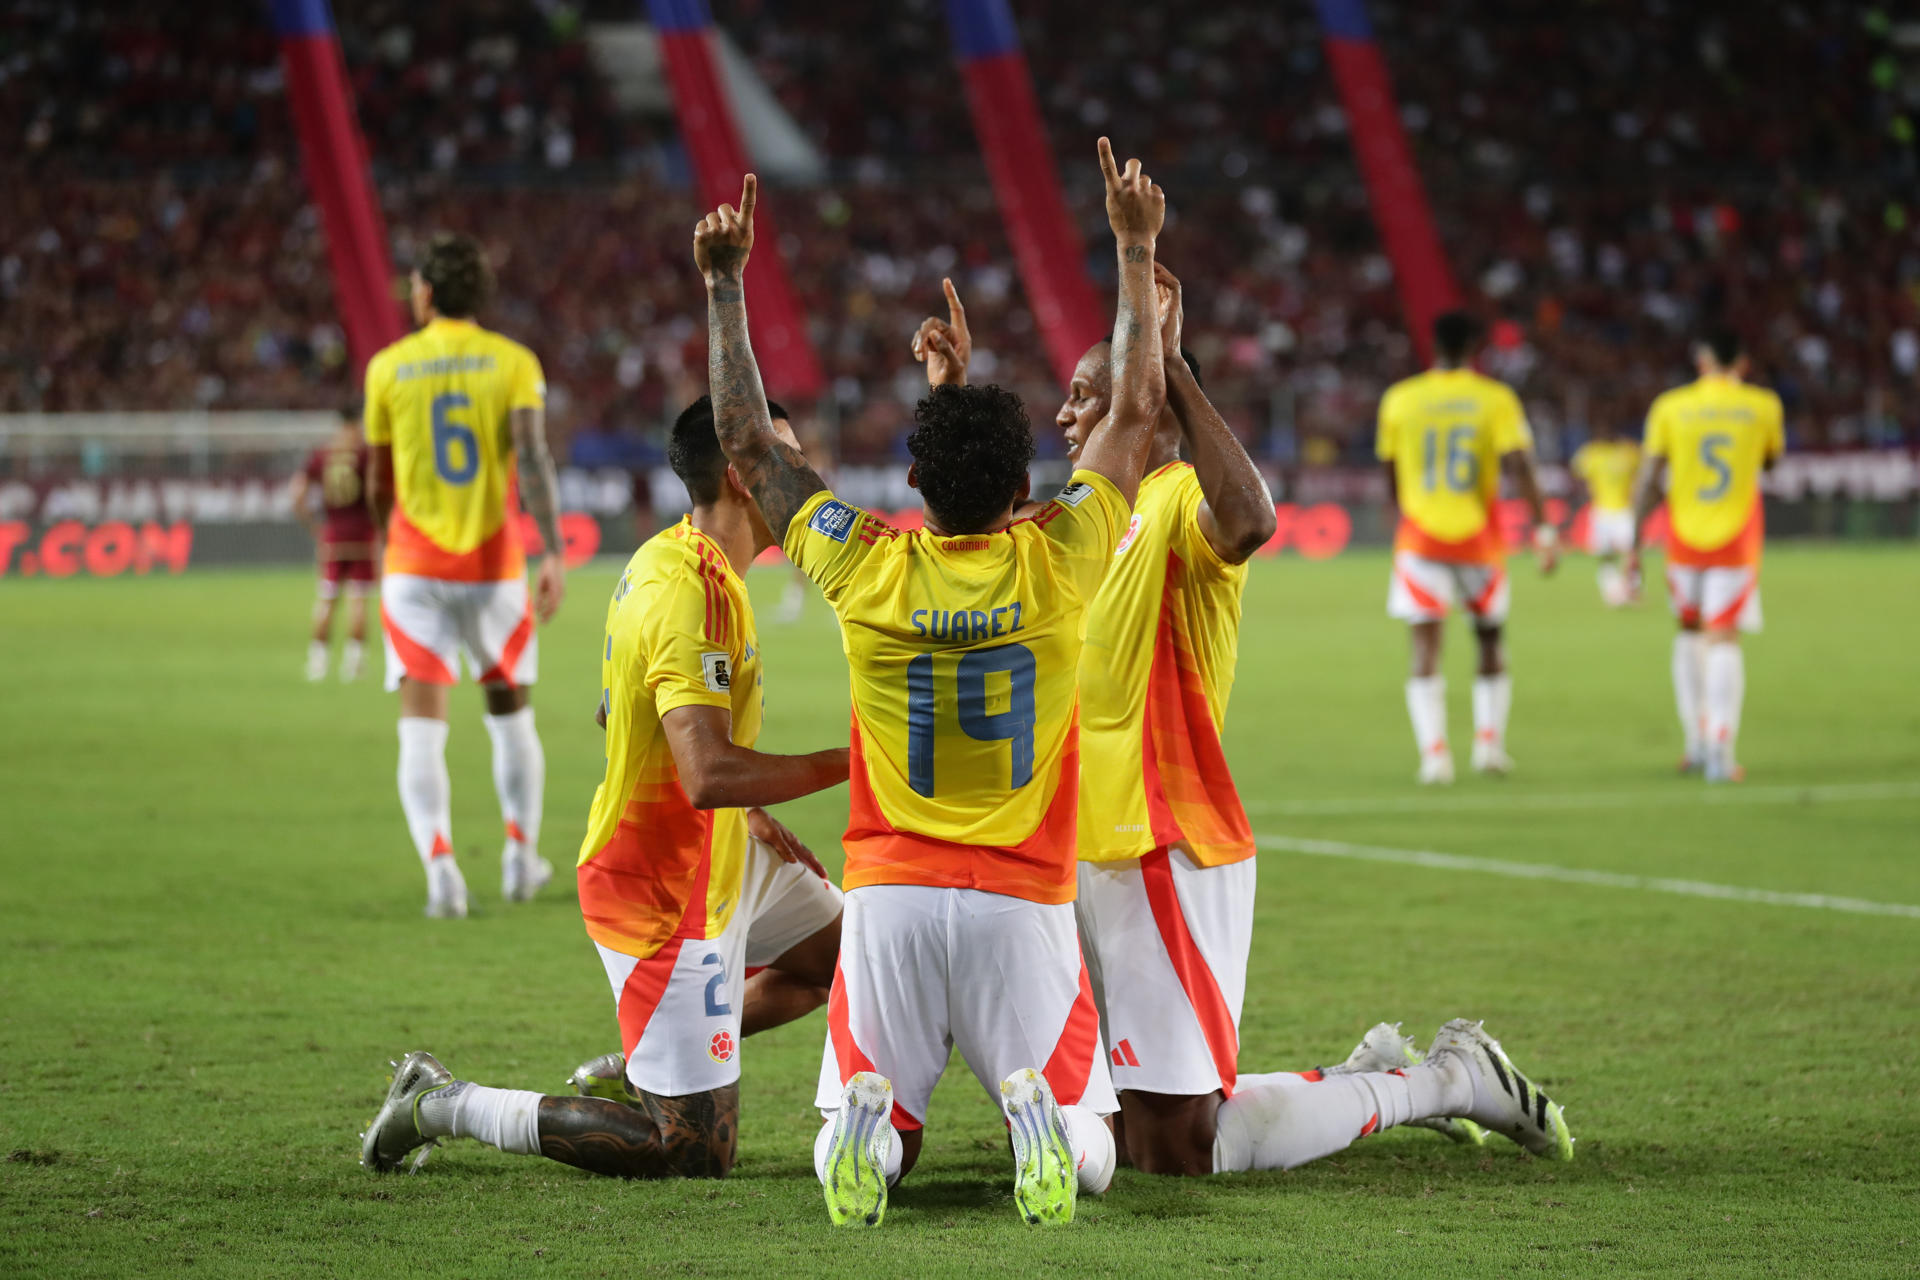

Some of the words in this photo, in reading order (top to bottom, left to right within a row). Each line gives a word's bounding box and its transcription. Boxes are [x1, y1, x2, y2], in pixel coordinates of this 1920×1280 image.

[432, 391, 479, 486] 6
[1422, 425, 1479, 494] 16
[1697, 433, 1735, 502] 5
[942, 540, 990, 551] COLOMBIA
[911, 601, 1025, 641] SUAREZ
[907, 643, 1036, 798] 19
[702, 952, 732, 1017] 2
